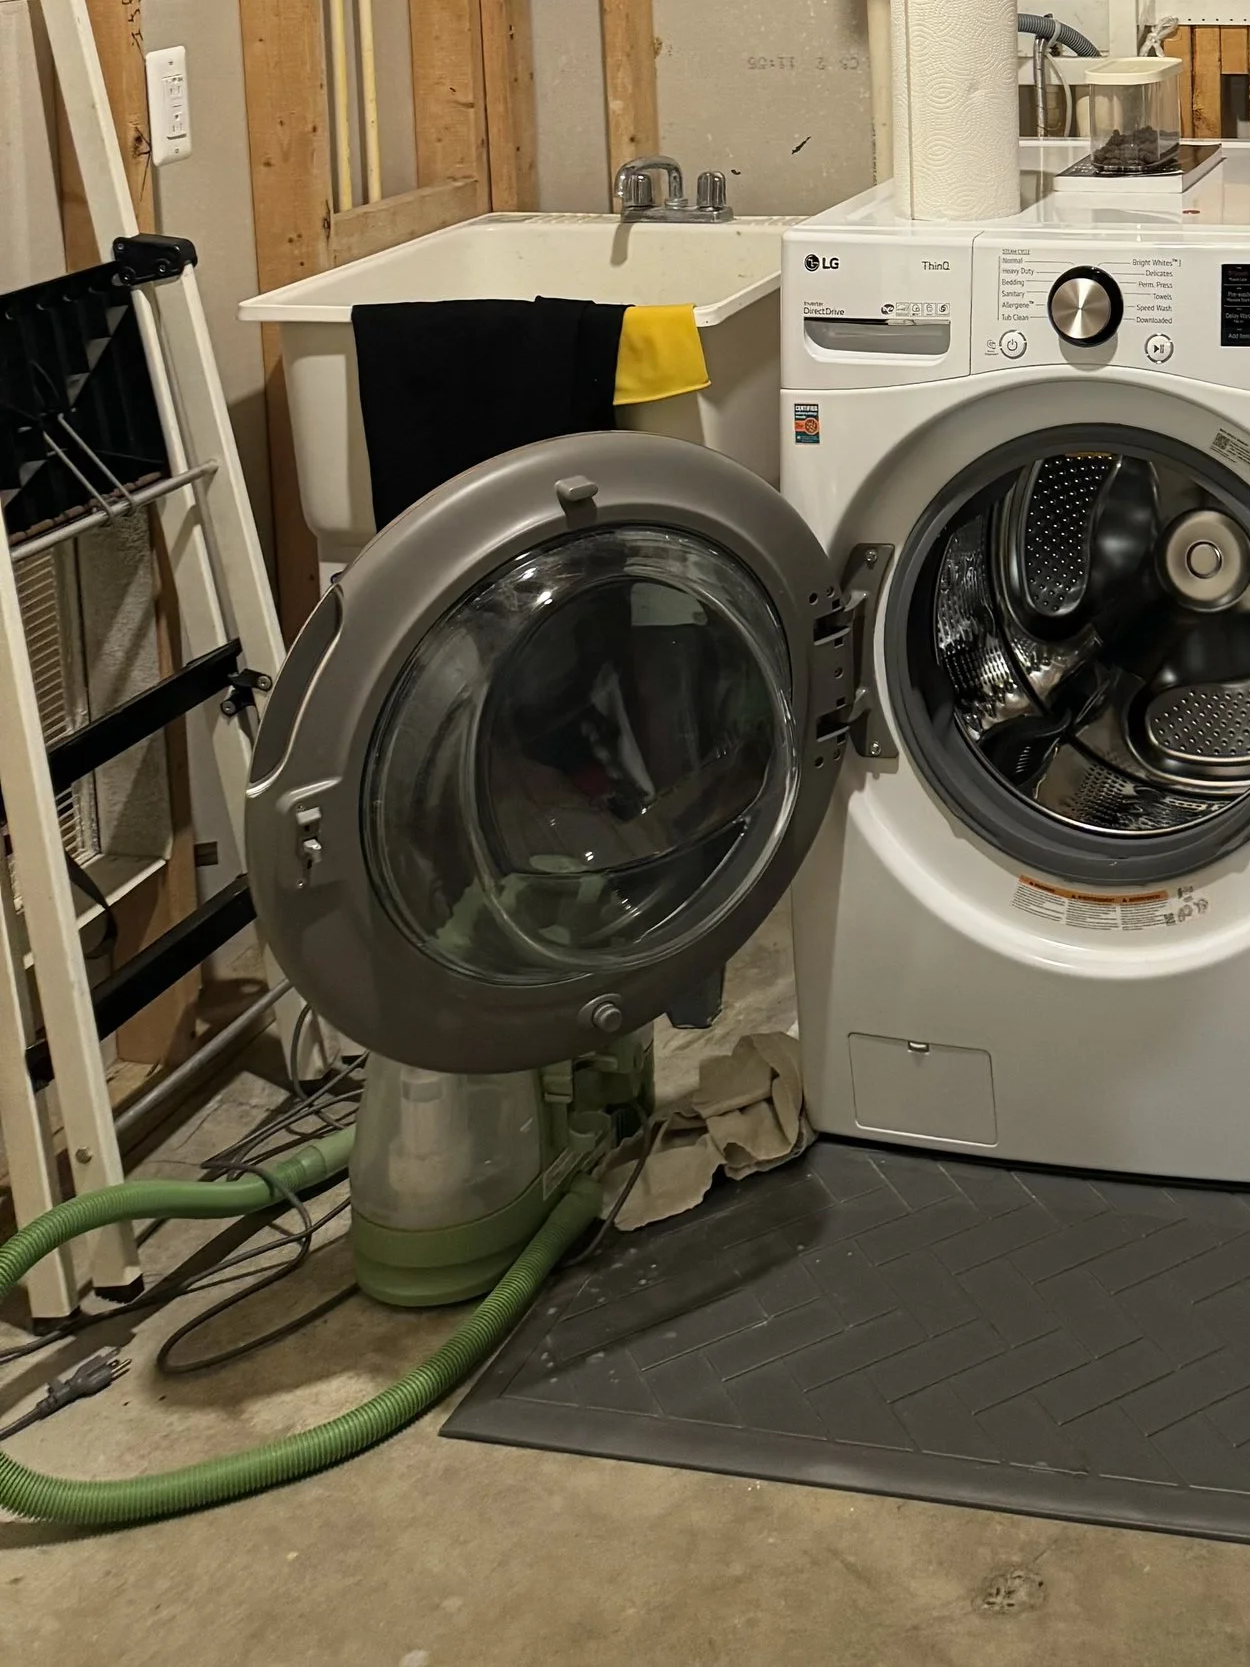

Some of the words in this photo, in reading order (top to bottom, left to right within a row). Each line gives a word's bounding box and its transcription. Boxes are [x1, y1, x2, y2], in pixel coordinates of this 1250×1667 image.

[822, 257, 839, 269] LG
[922, 261, 950, 270] ThinQ
[1002, 279, 1024, 287] Bedding
